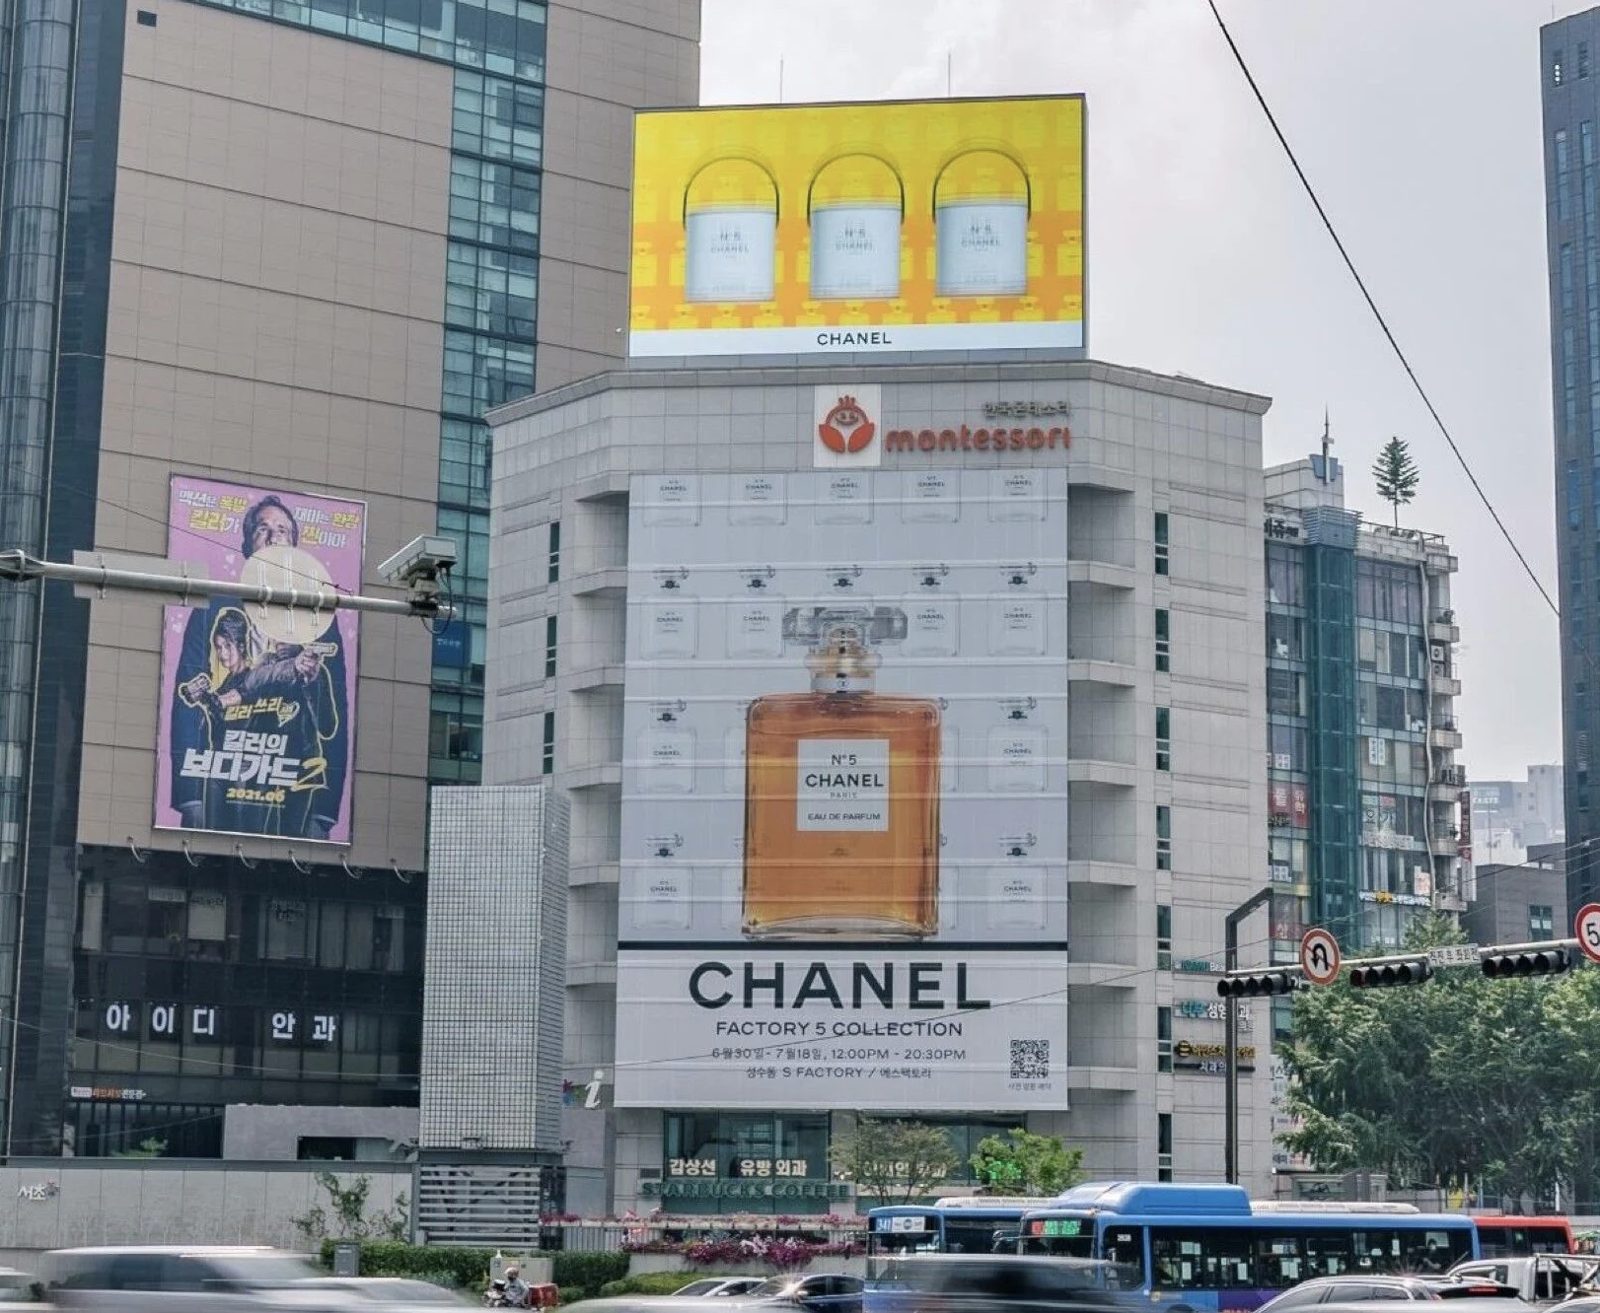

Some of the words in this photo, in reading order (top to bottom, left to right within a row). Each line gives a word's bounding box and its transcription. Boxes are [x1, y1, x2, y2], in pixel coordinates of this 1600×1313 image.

[817, 331, 892, 346] CHANEL
[885, 424, 1072, 453] montessori
[222, 729, 289, 756] 킬러의
[179, 747, 301, 787] 보디가드
[805, 773, 884, 788] CHANEL
[807, 812, 827, 820] EAU
[828, 812, 841, 820] DE
[843, 812, 881, 820] PARFUM
[689, 960, 991, 1010] CHANEL
[106, 1004, 215, 1035] 아이디
[272, 1012, 336, 1042] 안과
[716, 1021, 811, 1036] FACTORY
[815, 1022, 827, 1036] 5
[832, 1021, 963, 1038] COLLECTION
[831, 1048, 889, 1060] 12:00PM
[903, 1050, 967, 1061] 20:30PM
[746, 1066, 777, 1079] 성수동
[782, 1067, 792, 1079] S
[796, 1067, 862, 1079] FACTORY
[740, 1159, 772, 1177] 유방
[775, 1159, 807, 1177] 외과
[18, 1184, 46, 1201] 서초
[641, 1182, 765, 1198] STARBUCKS
[771, 1182, 850, 1198] COFFEE
